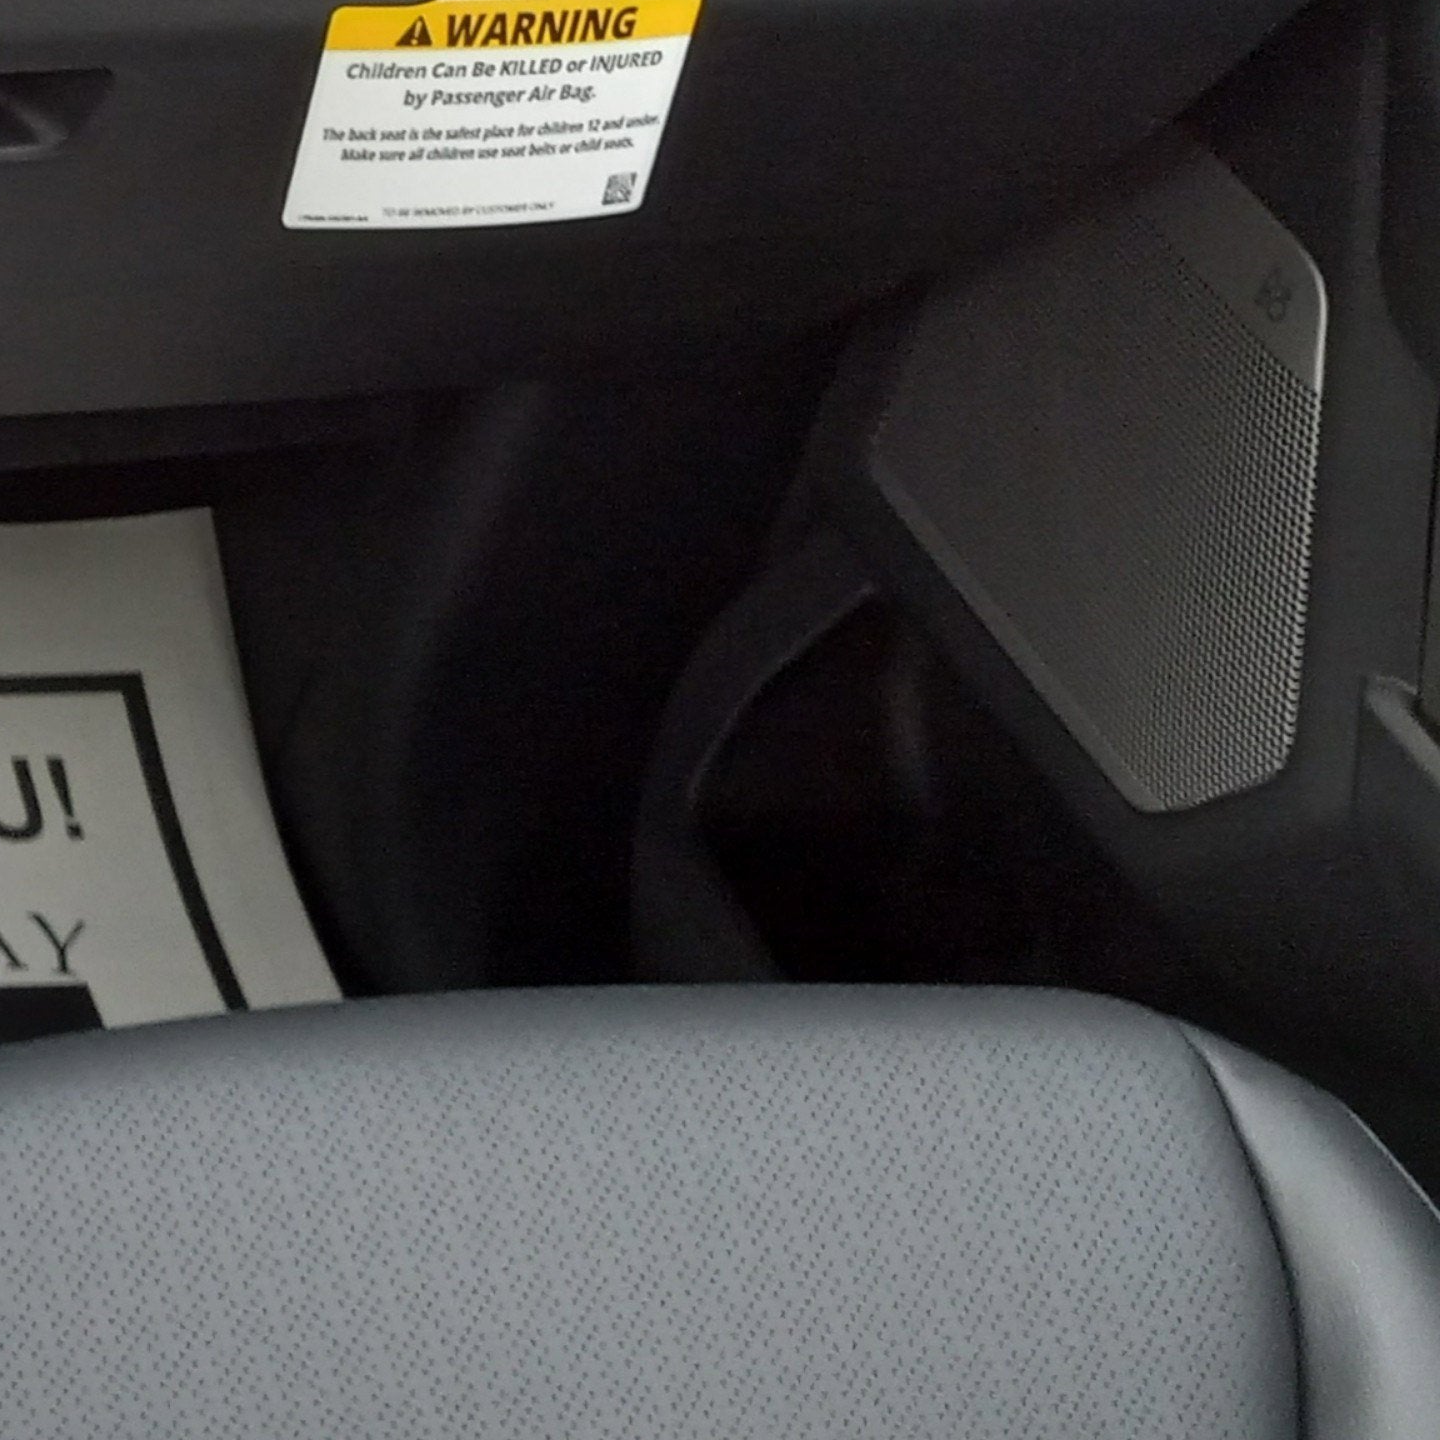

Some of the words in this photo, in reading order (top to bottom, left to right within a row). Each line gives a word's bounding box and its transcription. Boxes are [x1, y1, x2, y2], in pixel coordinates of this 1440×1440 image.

[444, 5, 640, 48] WARNING
[346, 61, 428, 80] Children
[431, 61, 468, 79] Can
[471, 60, 496, 78] Be
[498, 57, 563, 77] KILLED
[565, 59, 588, 74] or
[589, 49, 663, 74] INJURED
[402, 89, 428, 111] by
[430, 88, 526, 109] Passenger
[527, 83, 557, 102] Air
[558, 82, 597, 103] Bag.
[322, 127, 346, 142] The
[347, 127, 377, 142] back
[379, 128, 407, 142] seat
[421, 126, 443, 141] the
[444, 125, 482, 141] safest
[482, 124, 515, 142] place
[516, 123, 535, 138] for
[536, 121, 584, 136] children
[602, 116, 625, 131] and
[340, 147, 376, 162] Make
[425, 146, 475, 161] children
